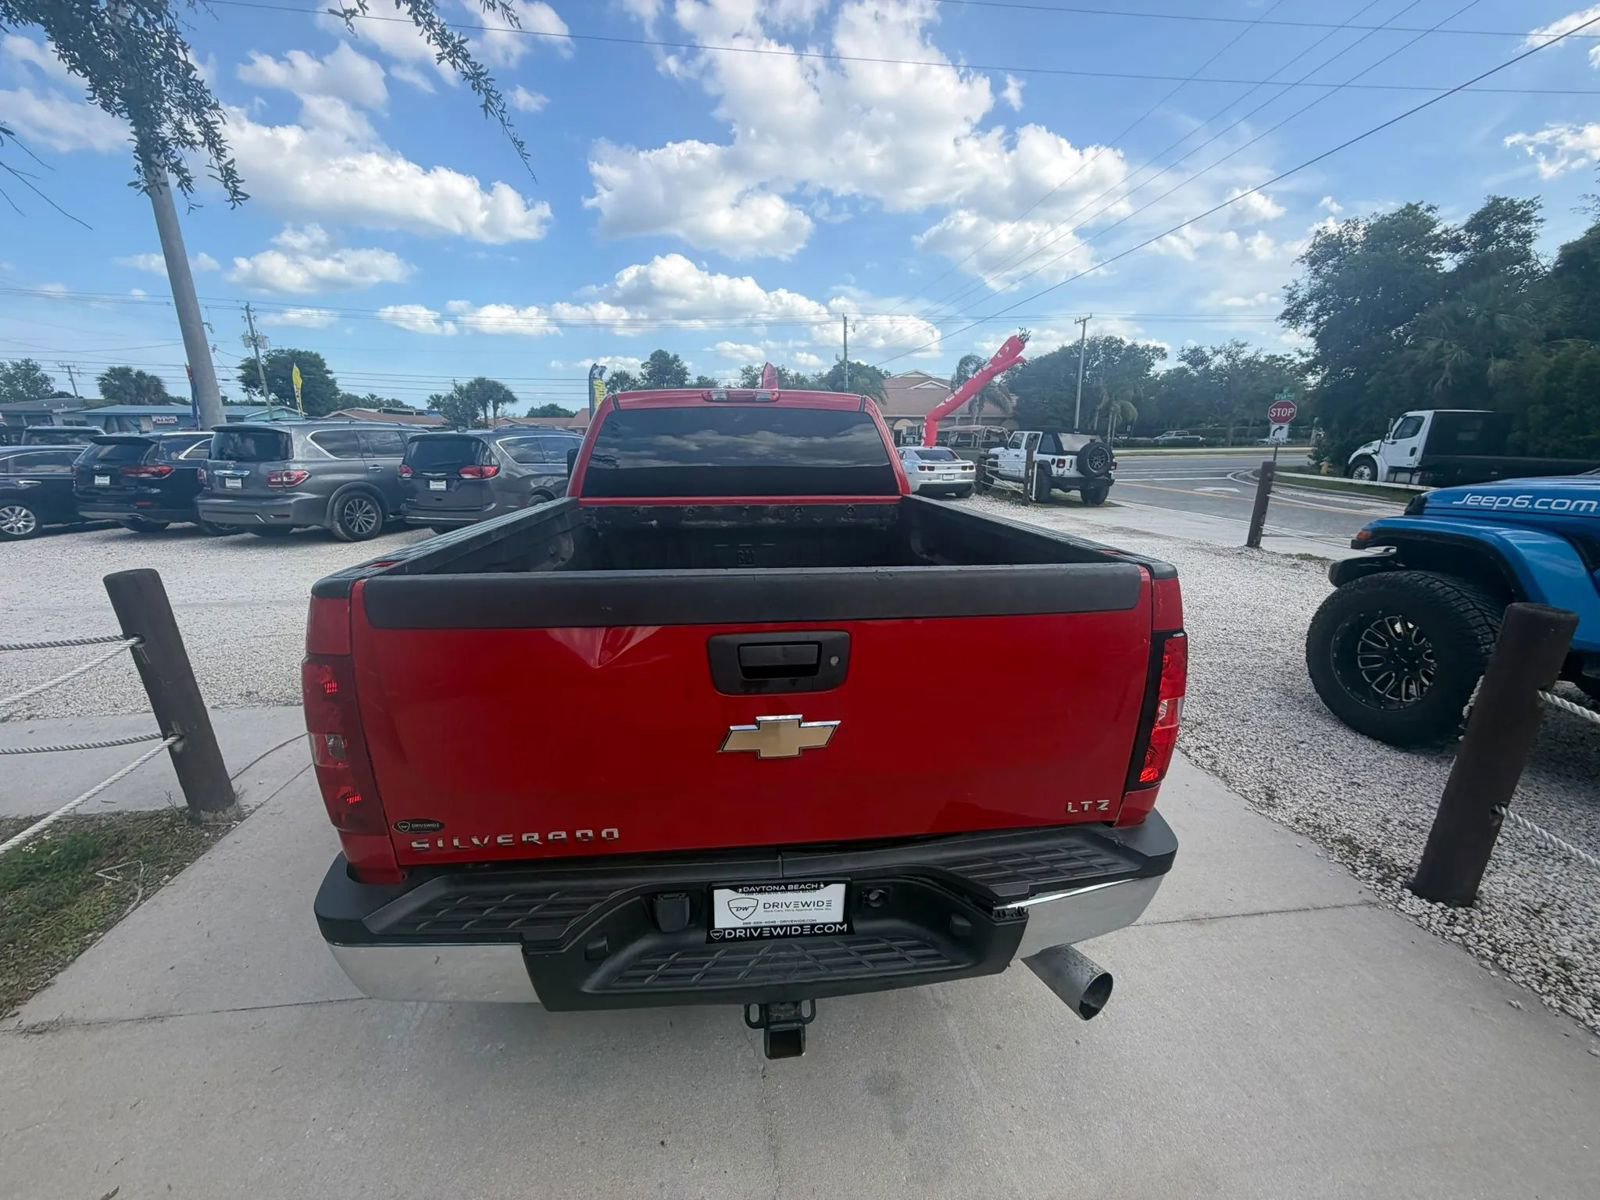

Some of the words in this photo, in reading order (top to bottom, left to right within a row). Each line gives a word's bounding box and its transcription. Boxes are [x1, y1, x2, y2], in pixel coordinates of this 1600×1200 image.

[1270, 407, 1295, 417] STOP
[1452, 493, 1599, 512] Jeep6.com
[1067, 800, 1110, 812] LTZ
[410, 828, 620, 849] SILVERADO
[743, 884, 786, 892] DAYTONA
[762, 900, 832, 909] DRIVEWIDE
[724, 924, 848, 939] DRIVEWIDE.COM
